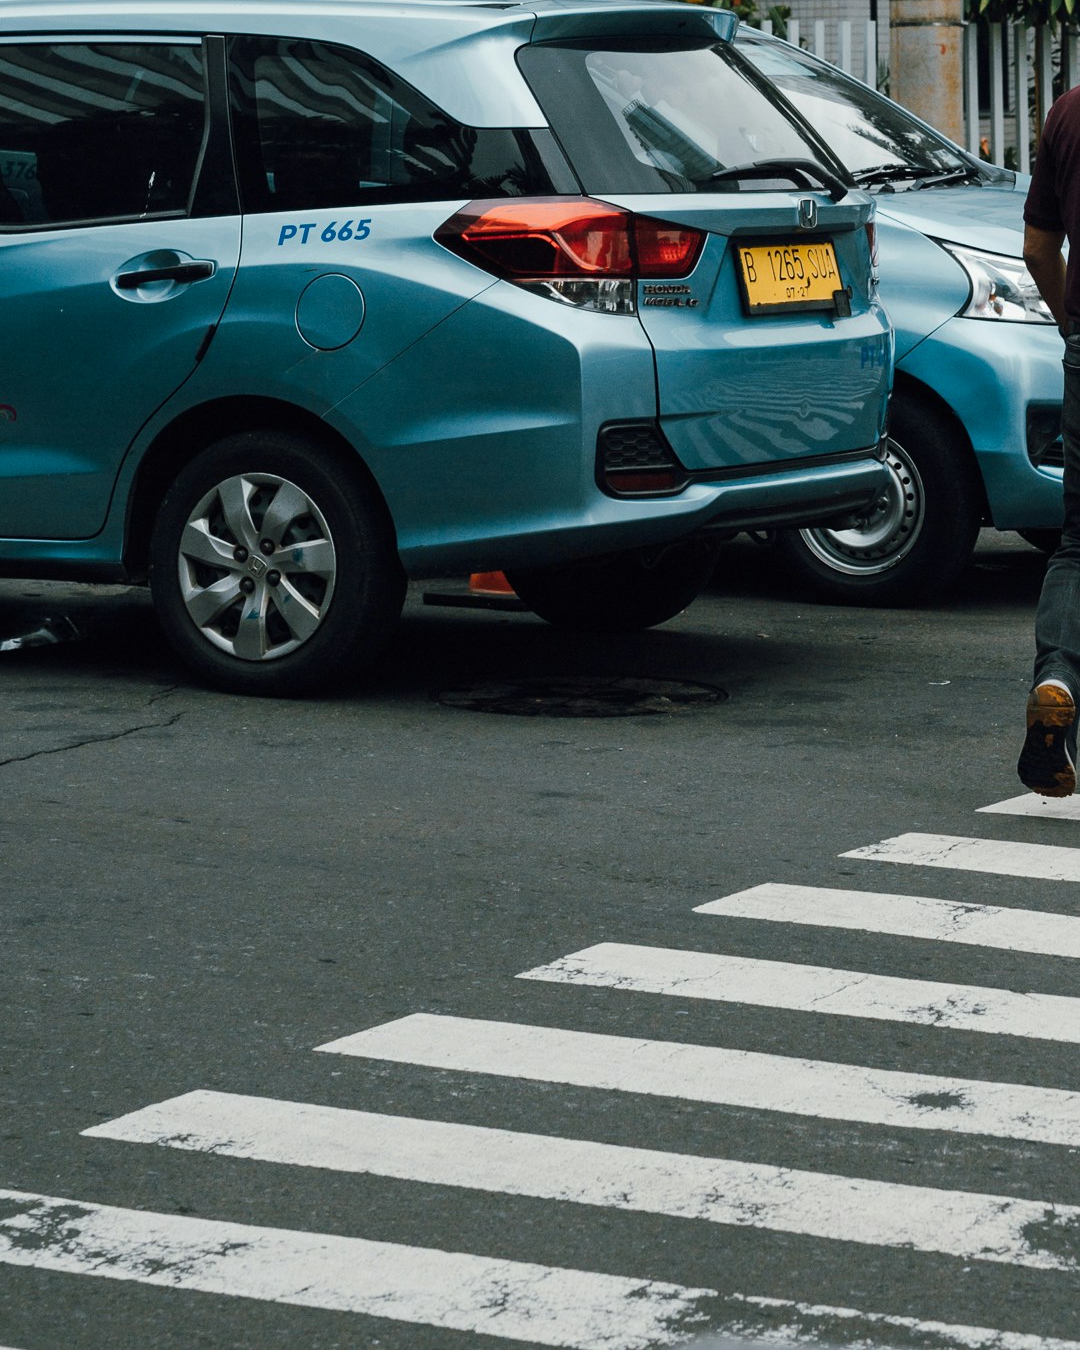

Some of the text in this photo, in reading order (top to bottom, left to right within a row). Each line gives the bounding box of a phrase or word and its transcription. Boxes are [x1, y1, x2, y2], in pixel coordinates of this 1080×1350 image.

[278, 218, 372, 246] PT 665
[744, 247, 836, 283] B 1265 SUA
[644, 284, 692, 295] HONDA
